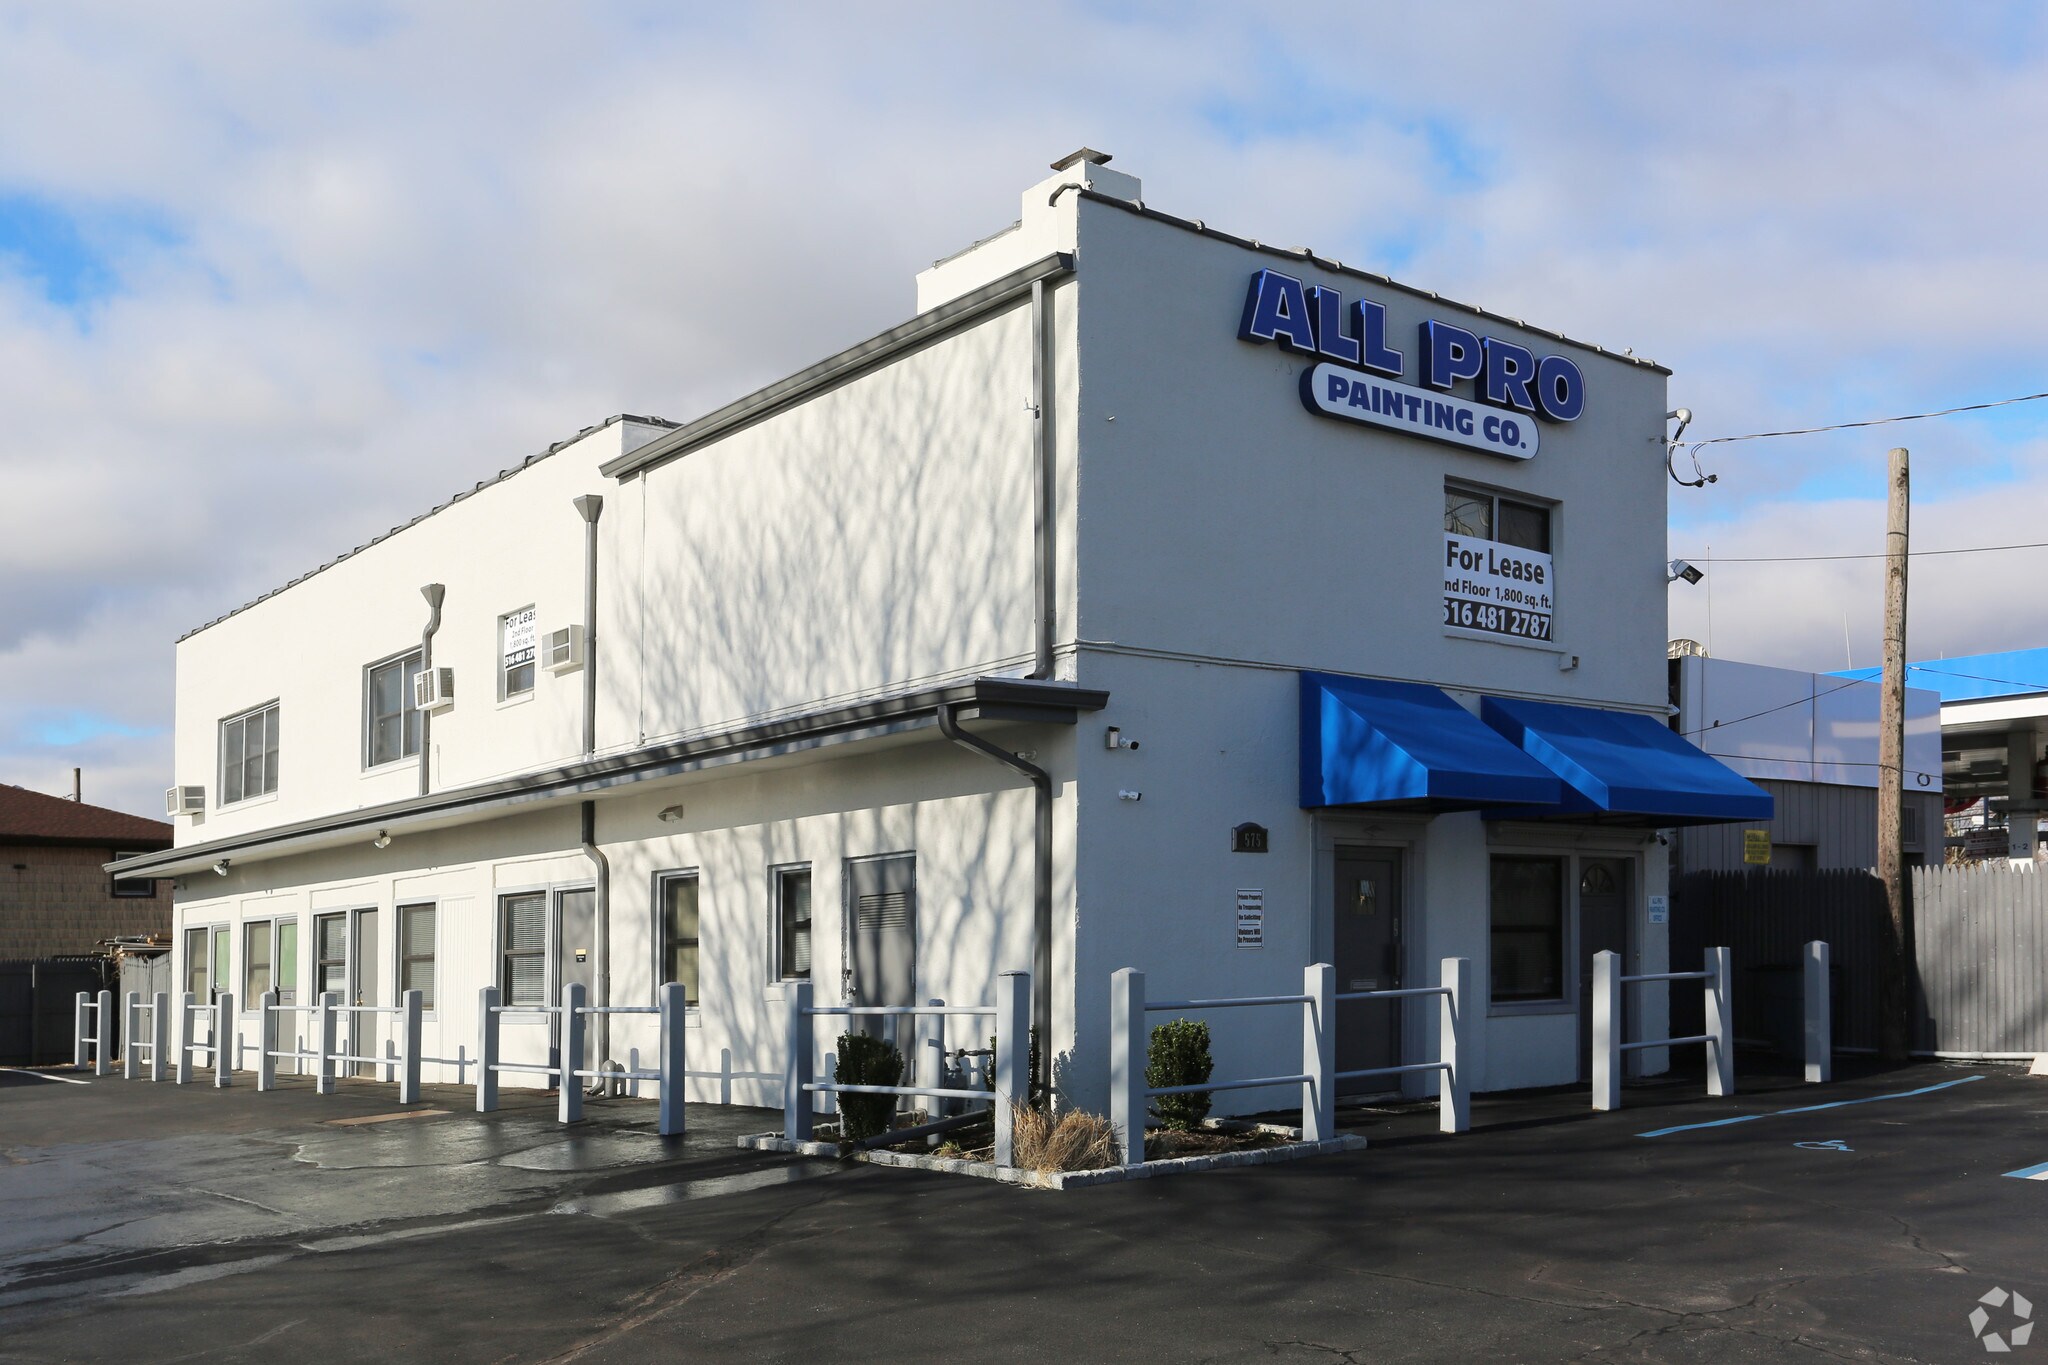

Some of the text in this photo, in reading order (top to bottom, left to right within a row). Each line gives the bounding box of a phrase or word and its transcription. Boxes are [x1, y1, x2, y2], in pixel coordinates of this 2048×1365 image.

[1239, 268, 1585, 423] ALL PRO
[1327, 374, 1527, 449] PAINTING CO.
[1446, 540, 1545, 585] For Lease
[1462, 579, 1491, 598] Floor
[1494, 586, 1523, 604] 1,800
[1524, 594, 1539, 609] sq.
[1540, 593, 1551, 609] ft.
[505, 616, 517, 630] For
[521, 625, 534, 635] Floor
[1476, 605, 1506, 631] 481
[1510, 610, 1550, 638] 2787
